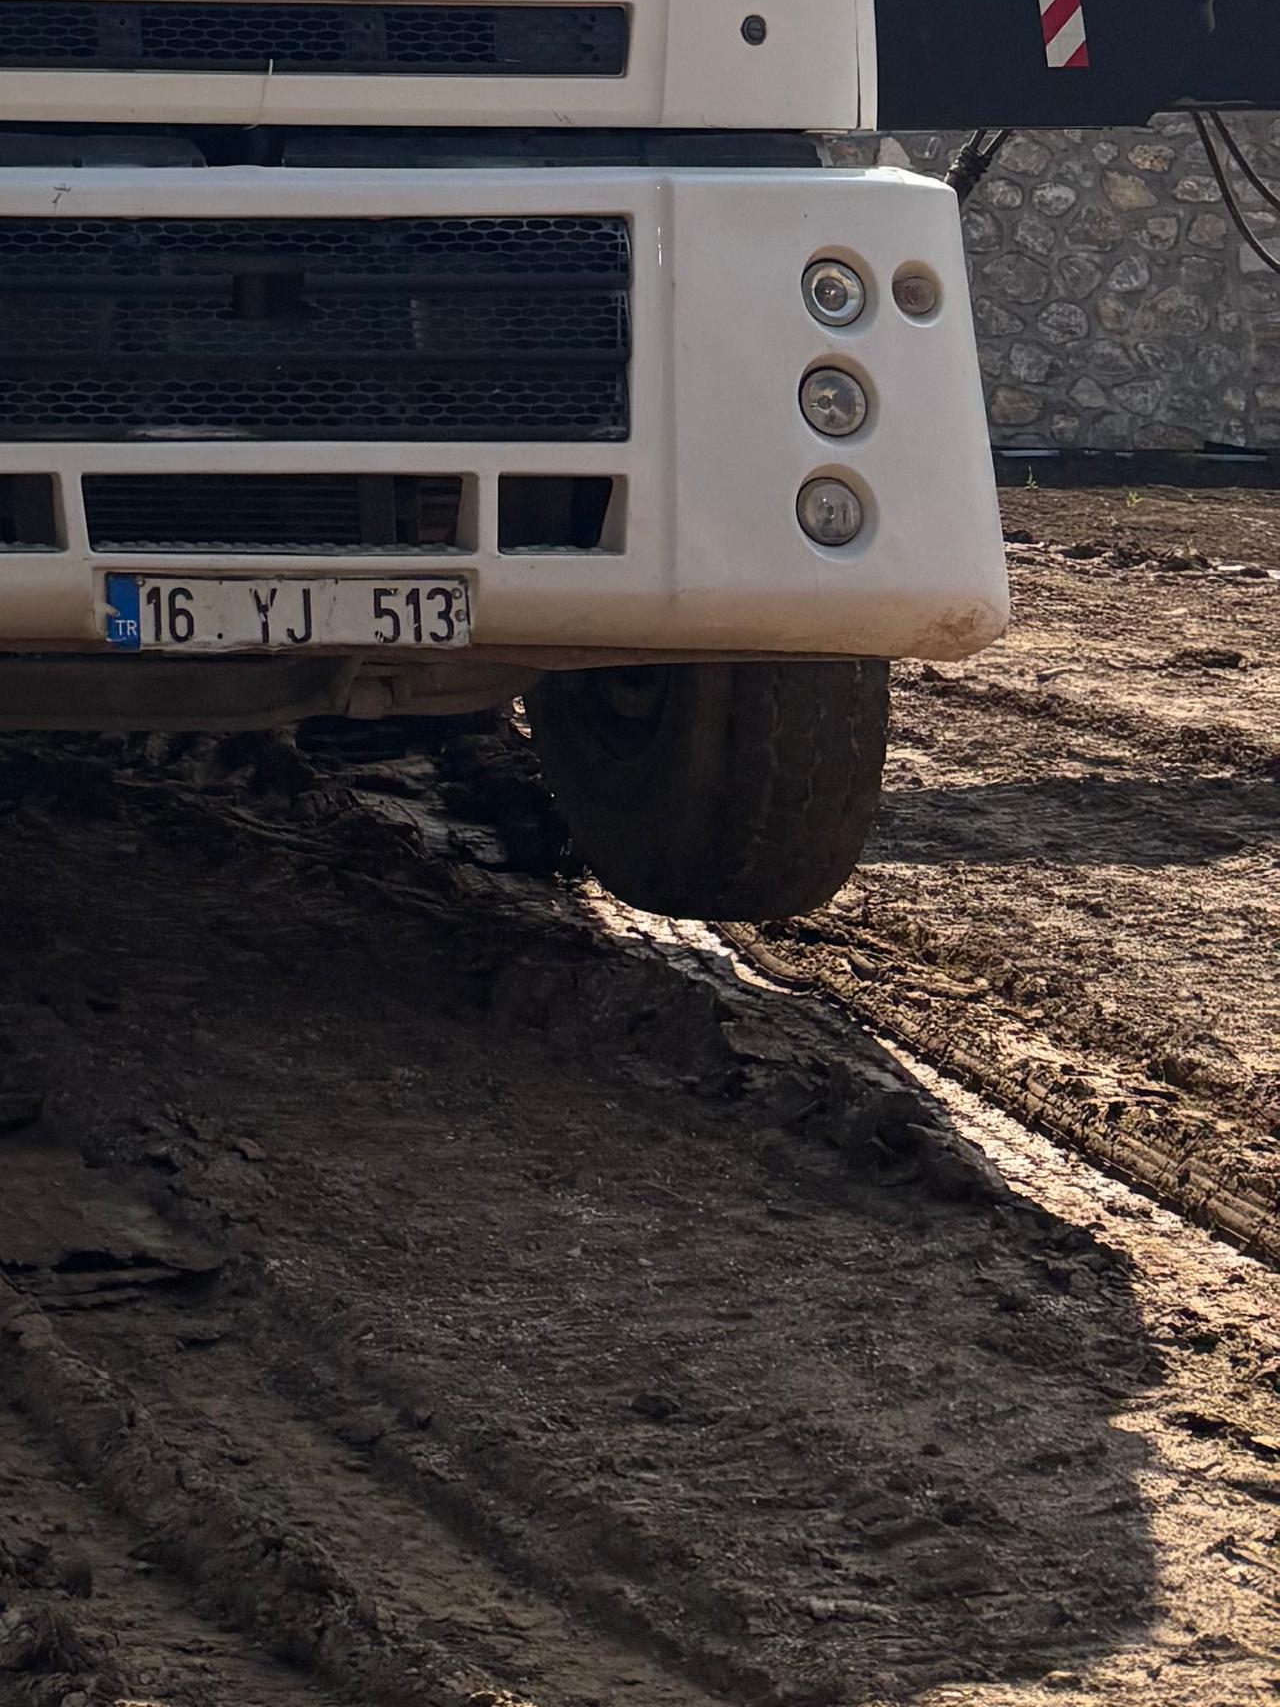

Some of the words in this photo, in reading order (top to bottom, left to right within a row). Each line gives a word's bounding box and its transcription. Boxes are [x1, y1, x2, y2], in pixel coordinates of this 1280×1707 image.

[114, 619, 138, 636] TR
[145, 586, 195, 643] 16
[249, 587, 312, 644] YJ
[372, 587, 455, 644] 513
